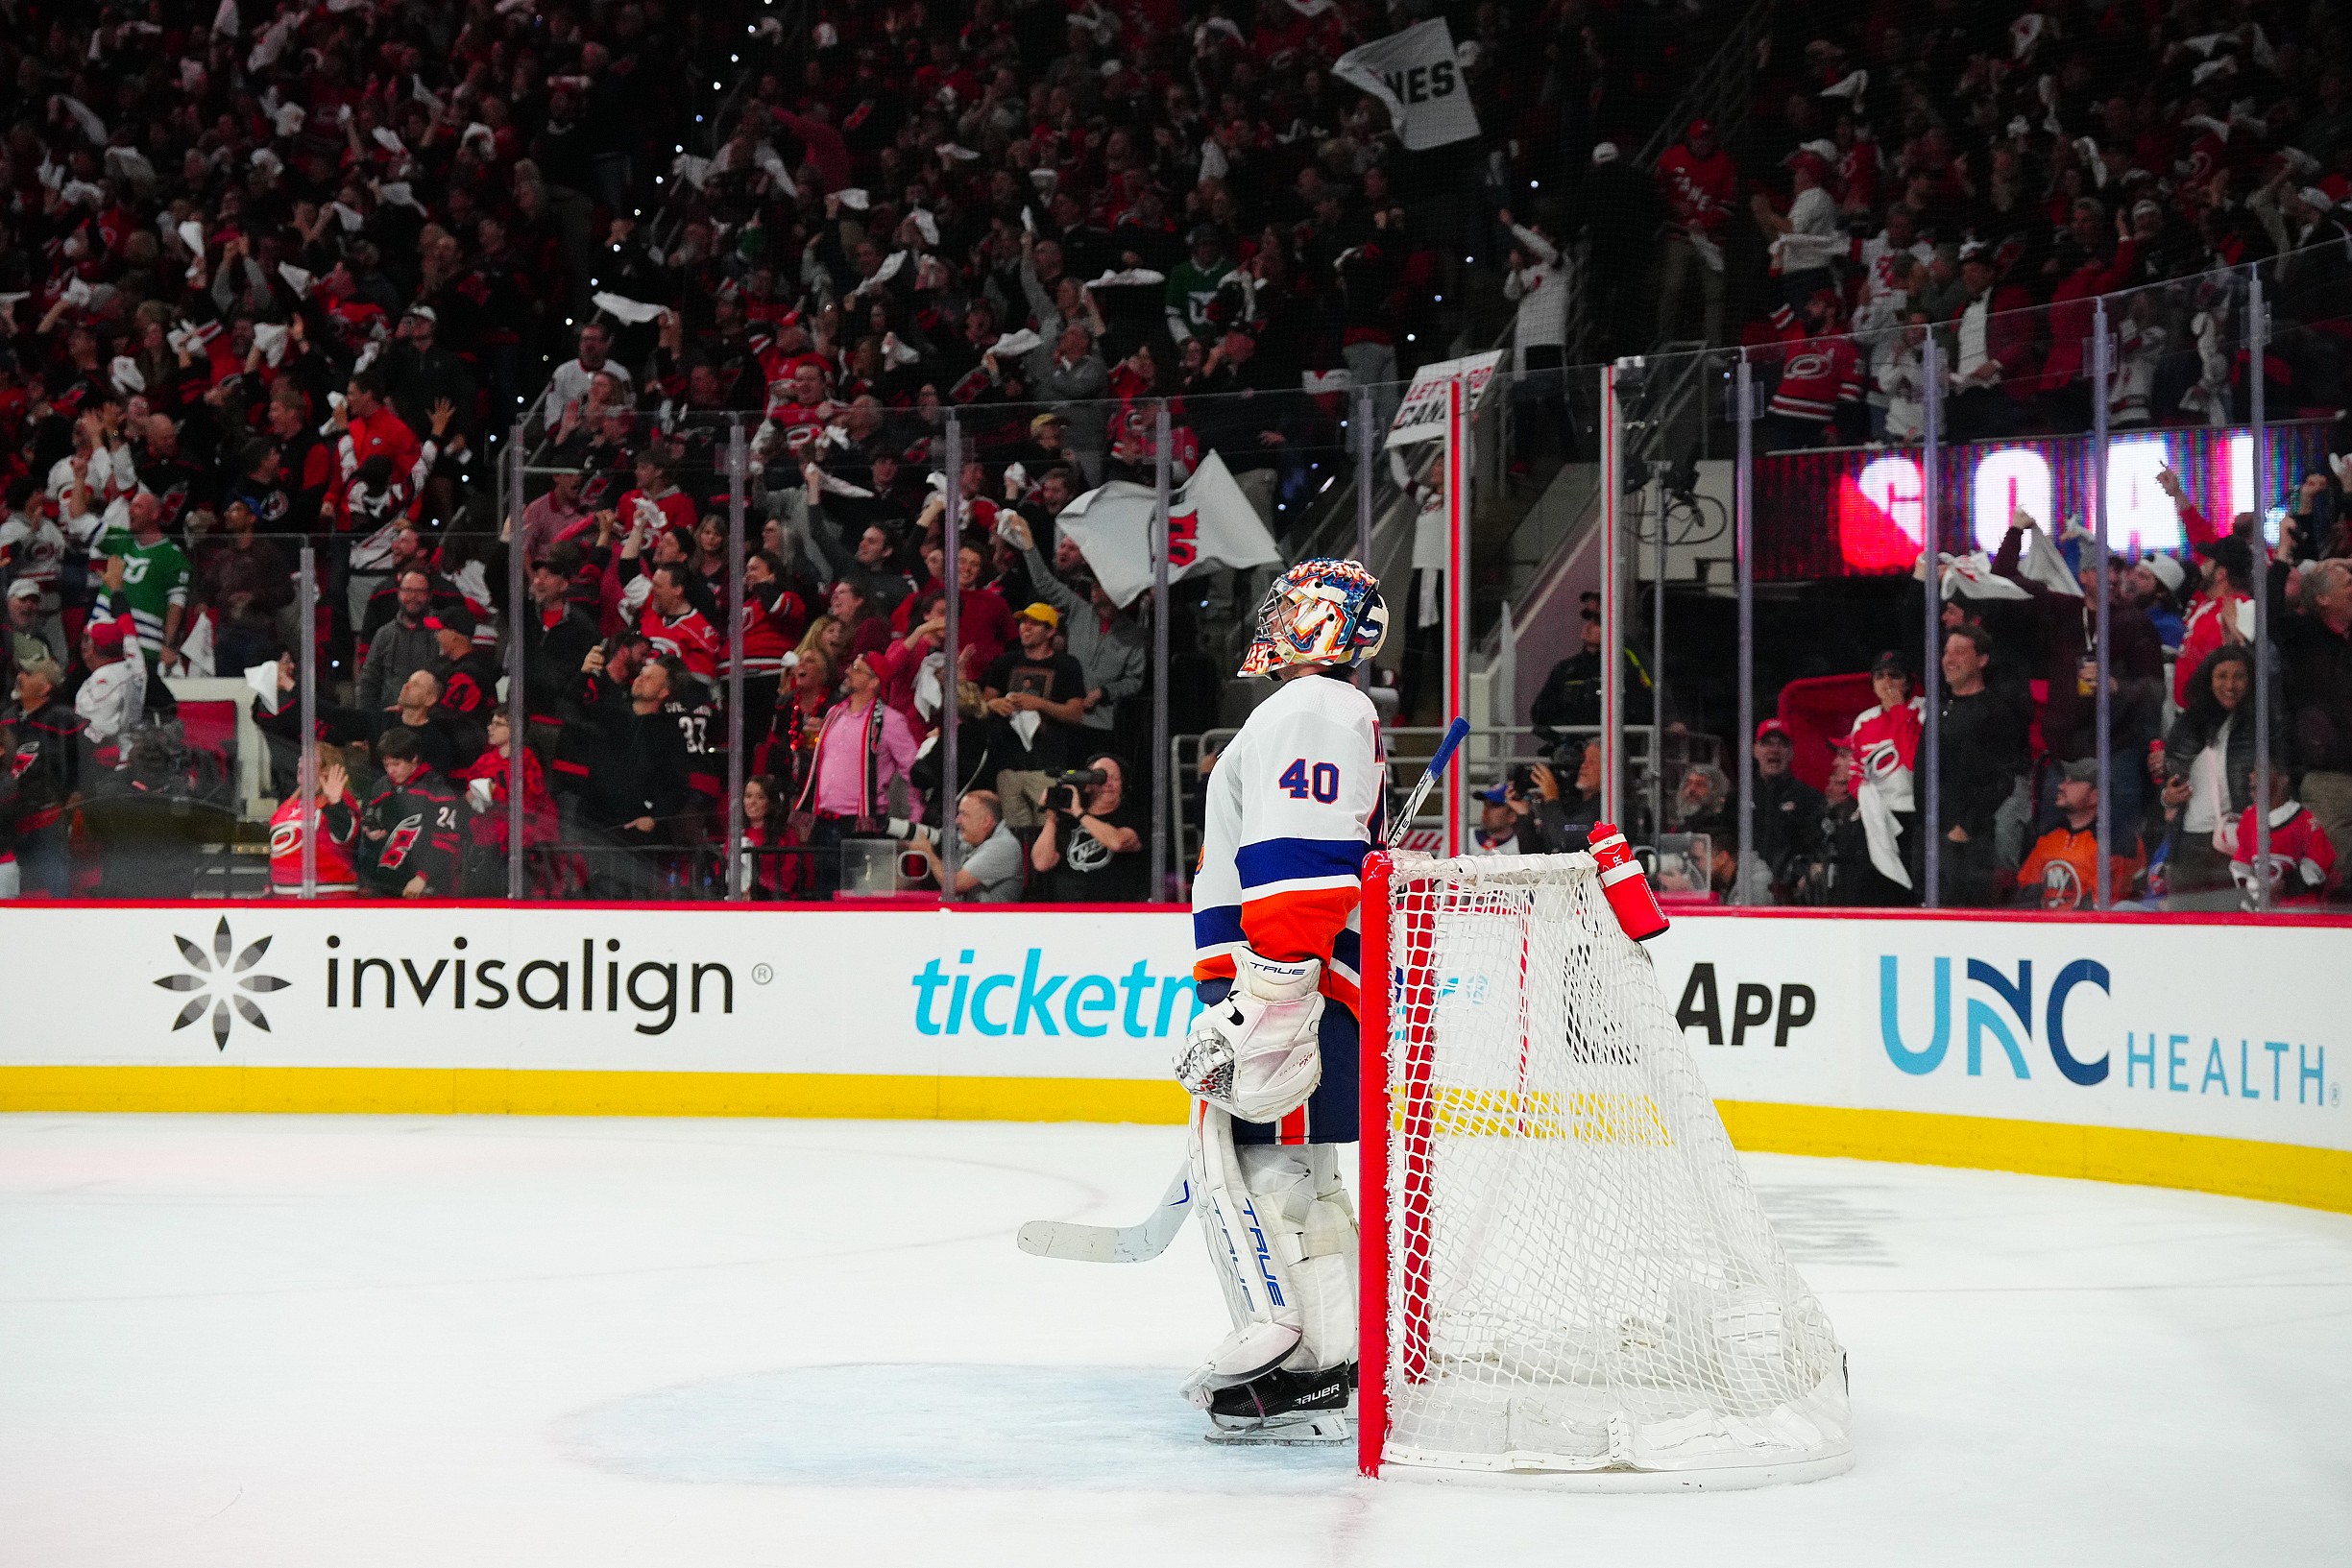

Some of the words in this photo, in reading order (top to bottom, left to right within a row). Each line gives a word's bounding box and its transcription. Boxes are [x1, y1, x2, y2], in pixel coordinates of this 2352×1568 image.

[1278, 758, 1341, 805] 40
[436, 807, 457, 831] 24
[327, 935, 734, 1035] invisalign
[1249, 961, 1307, 977] TRUE
[1879, 954, 2111, 1087] UNC
[2126, 1031, 2325, 1107] HEALTH
[1242, 1196, 1287, 1308] TRUE
